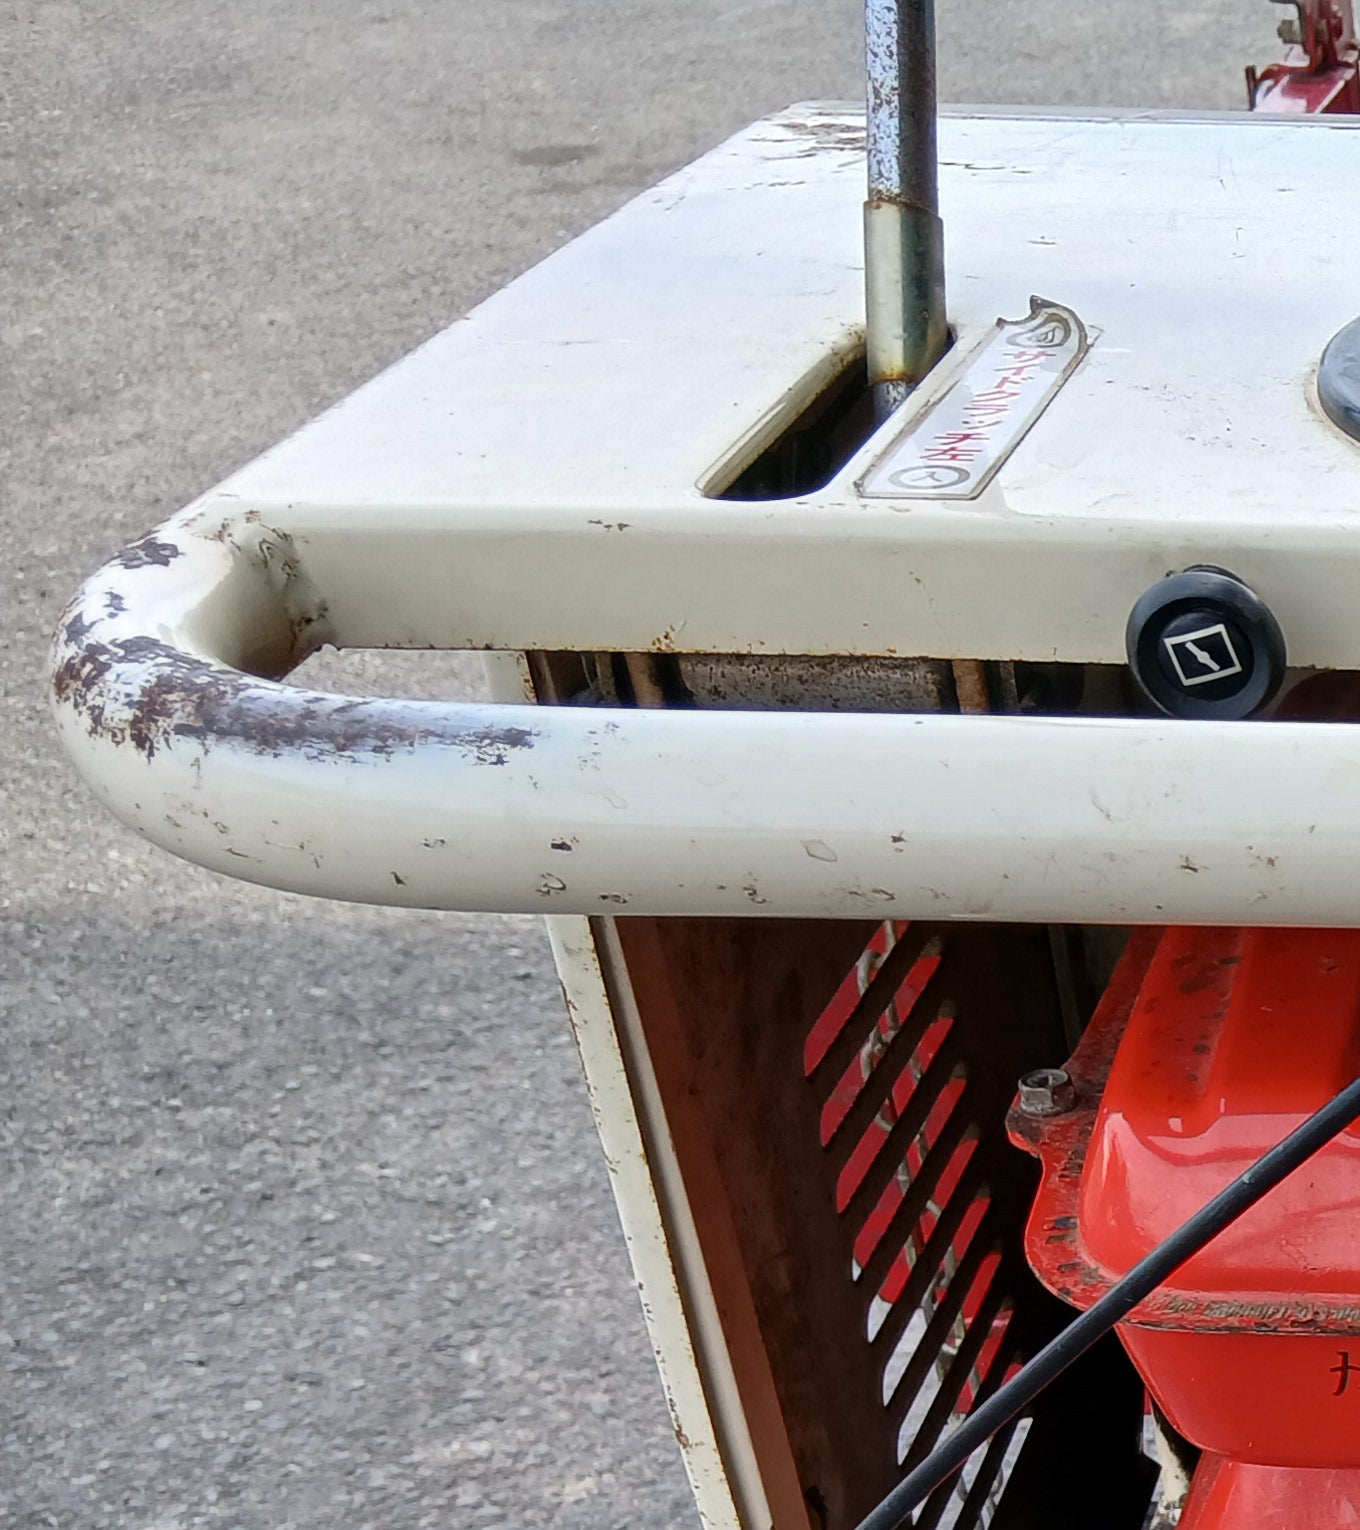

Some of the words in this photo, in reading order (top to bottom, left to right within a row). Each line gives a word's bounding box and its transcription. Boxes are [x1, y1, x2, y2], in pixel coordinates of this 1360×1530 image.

[919, 351, 1057, 462] サイドクラッチ左
